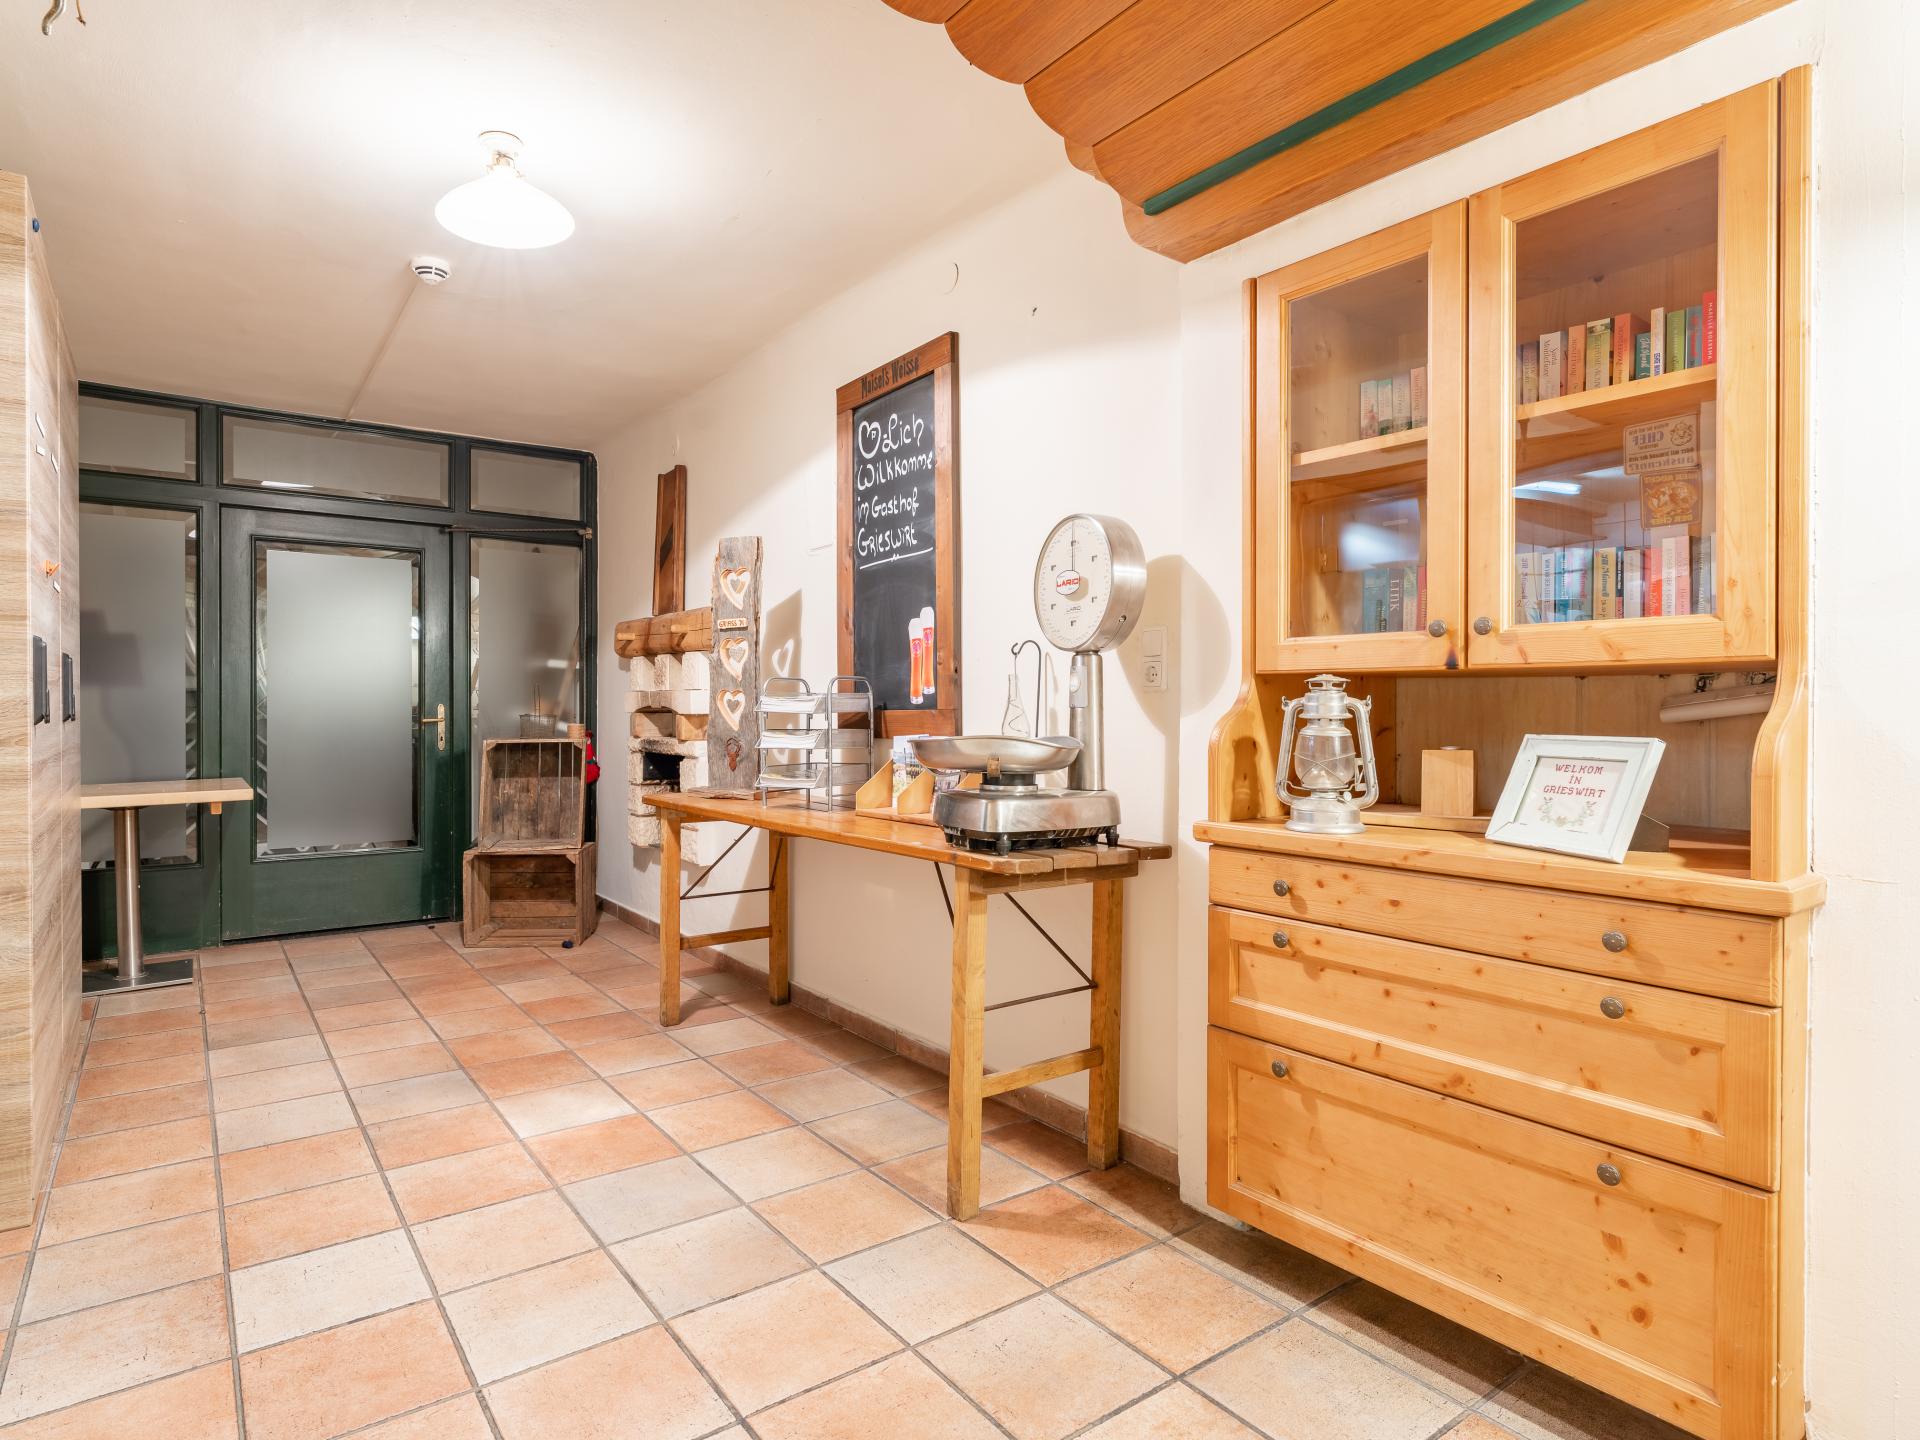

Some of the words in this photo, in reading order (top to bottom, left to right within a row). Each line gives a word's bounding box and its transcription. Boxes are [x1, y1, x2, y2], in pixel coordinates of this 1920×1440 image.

[1555, 763, 1604, 775] WELKOM
[1568, 775, 1582, 785] IN
[1543, 785, 1605, 798] GRIESWIRT
